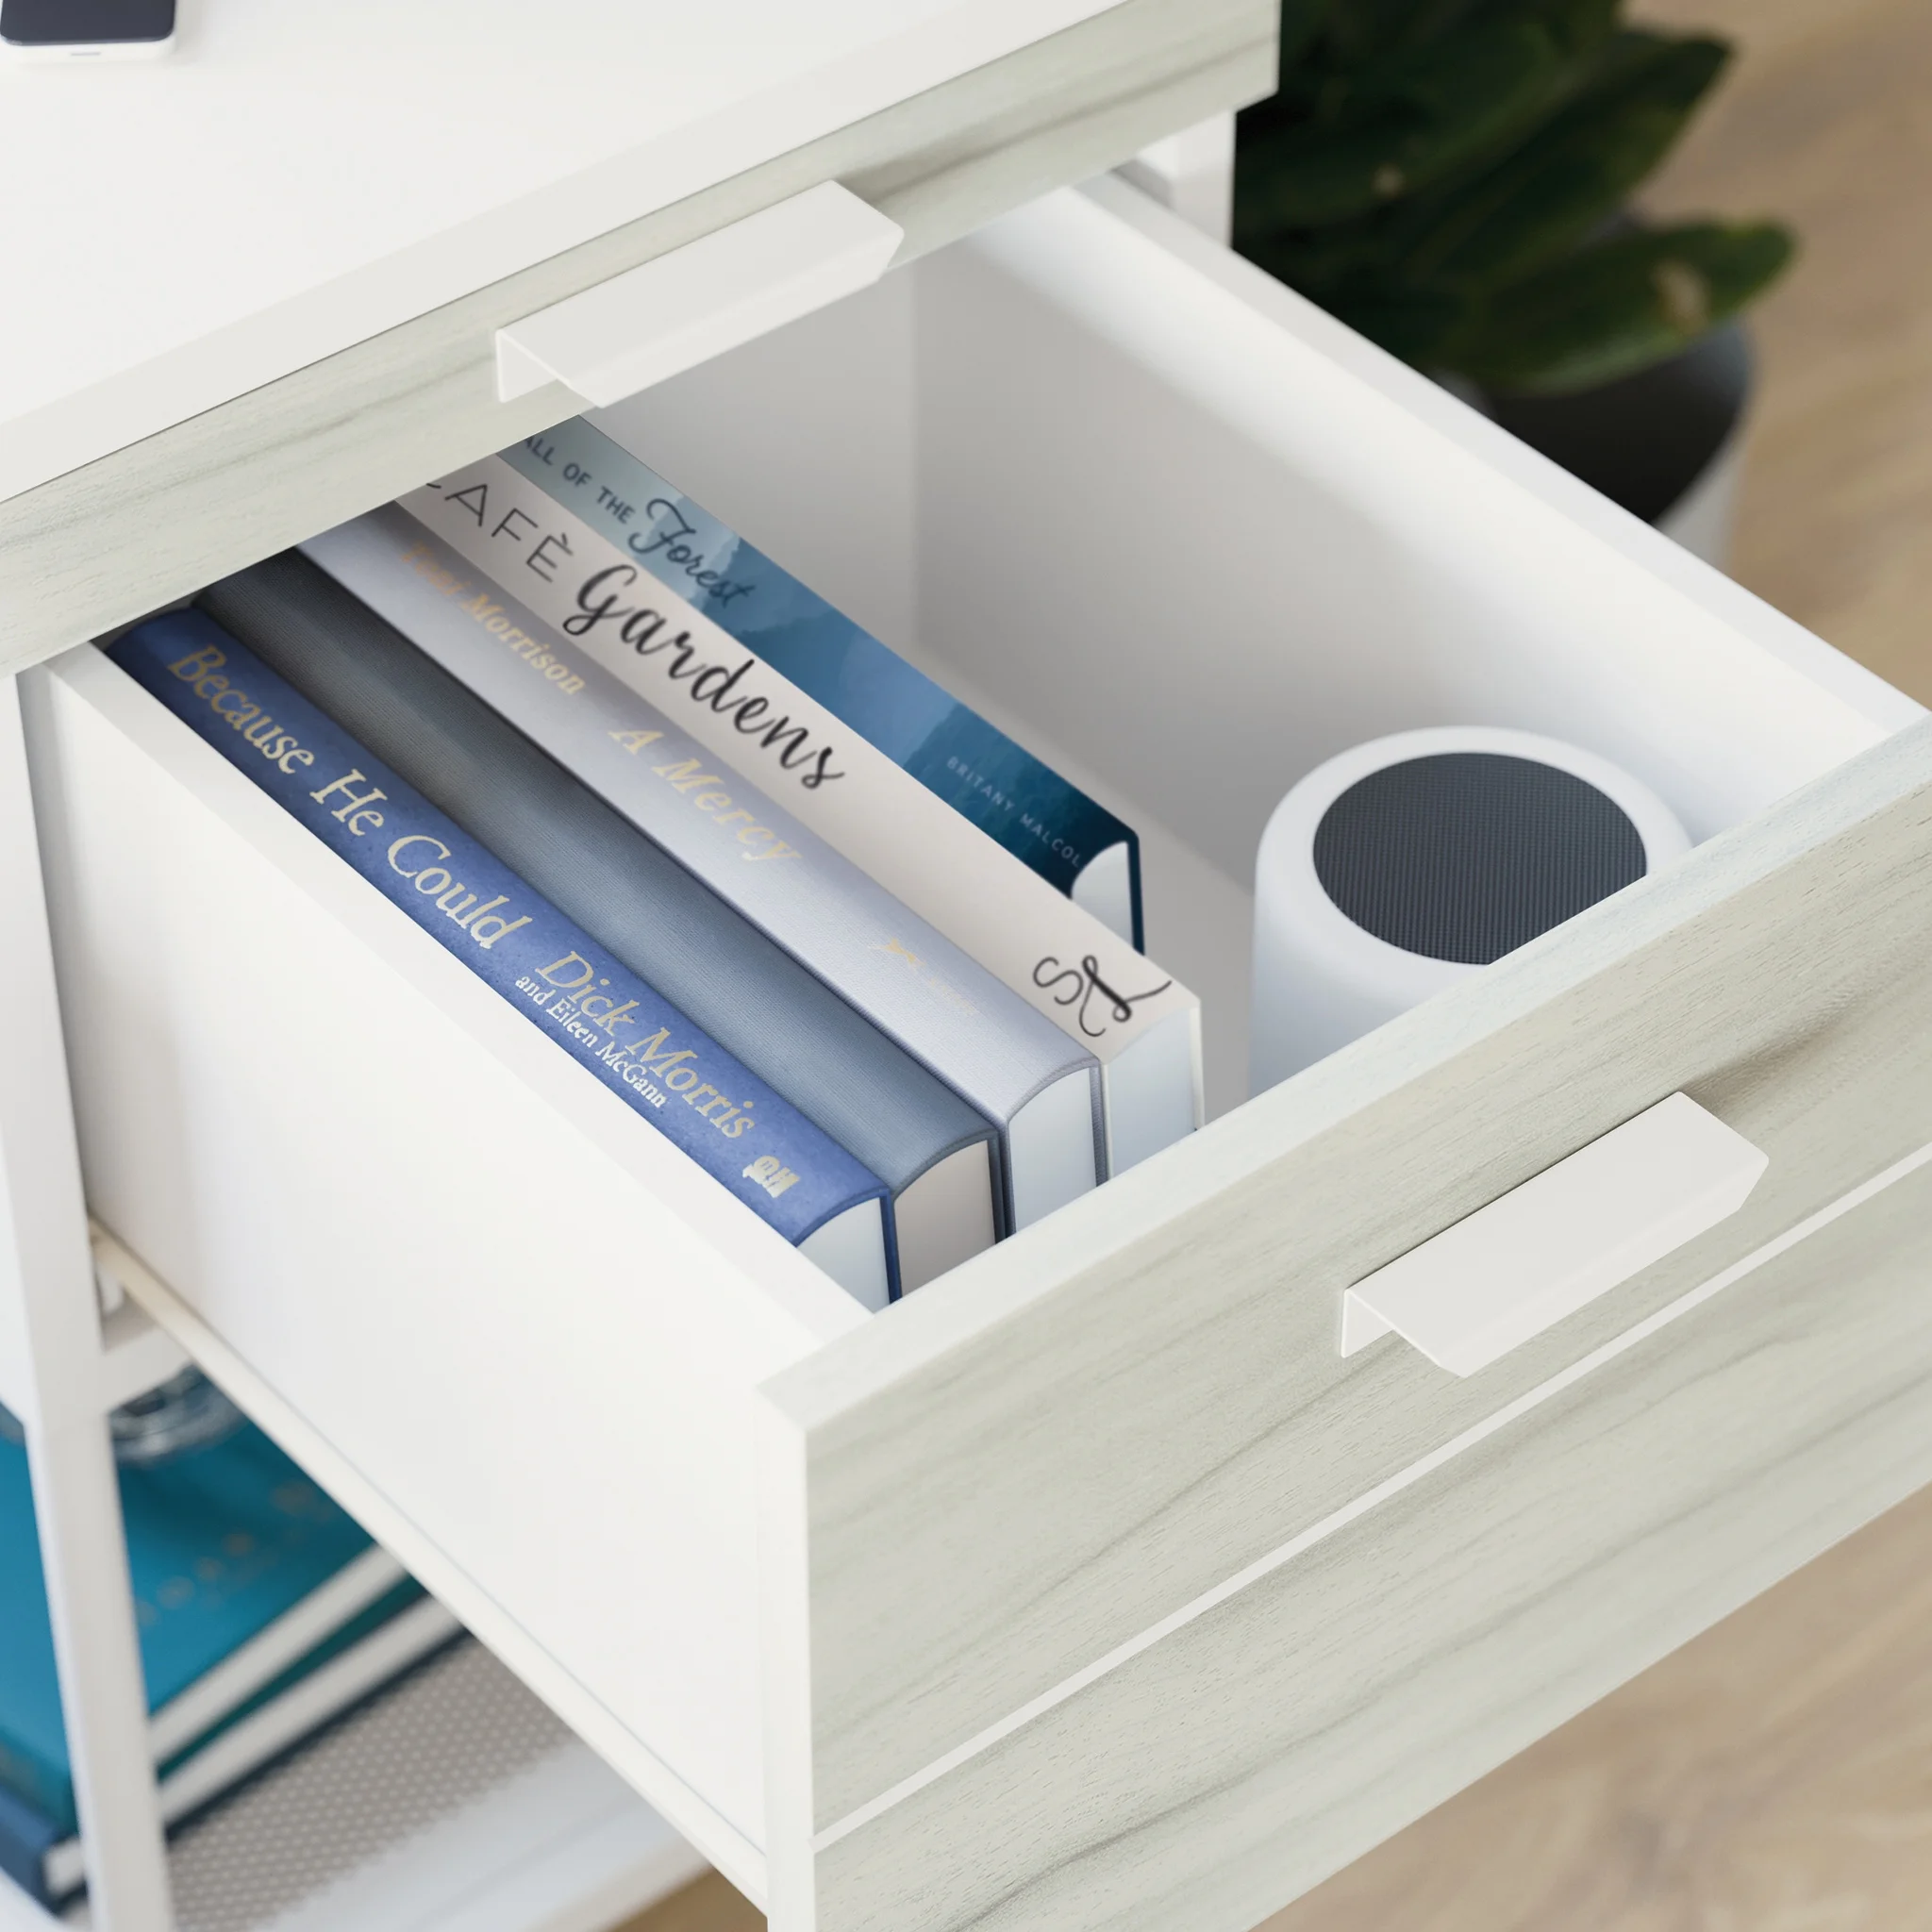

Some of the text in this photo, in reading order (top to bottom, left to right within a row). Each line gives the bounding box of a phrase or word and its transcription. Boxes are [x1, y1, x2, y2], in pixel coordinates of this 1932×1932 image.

[425, 482, 575, 583] AFÈ
[563, 462, 592, 487] OF
[596, 485, 636, 525] THE
[627, 497, 756, 608] Forest
[459, 591, 586, 696] Morrison
[562, 564, 845, 790] Gardens
[168, 643, 532, 949] Because He Could
[608, 729, 802, 862] A Mercy
[946, 756, 1015, 811] BRITANY
[515, 975, 669, 1108] and Eileen McGann
[535, 950, 755, 1139] Dick Morris
